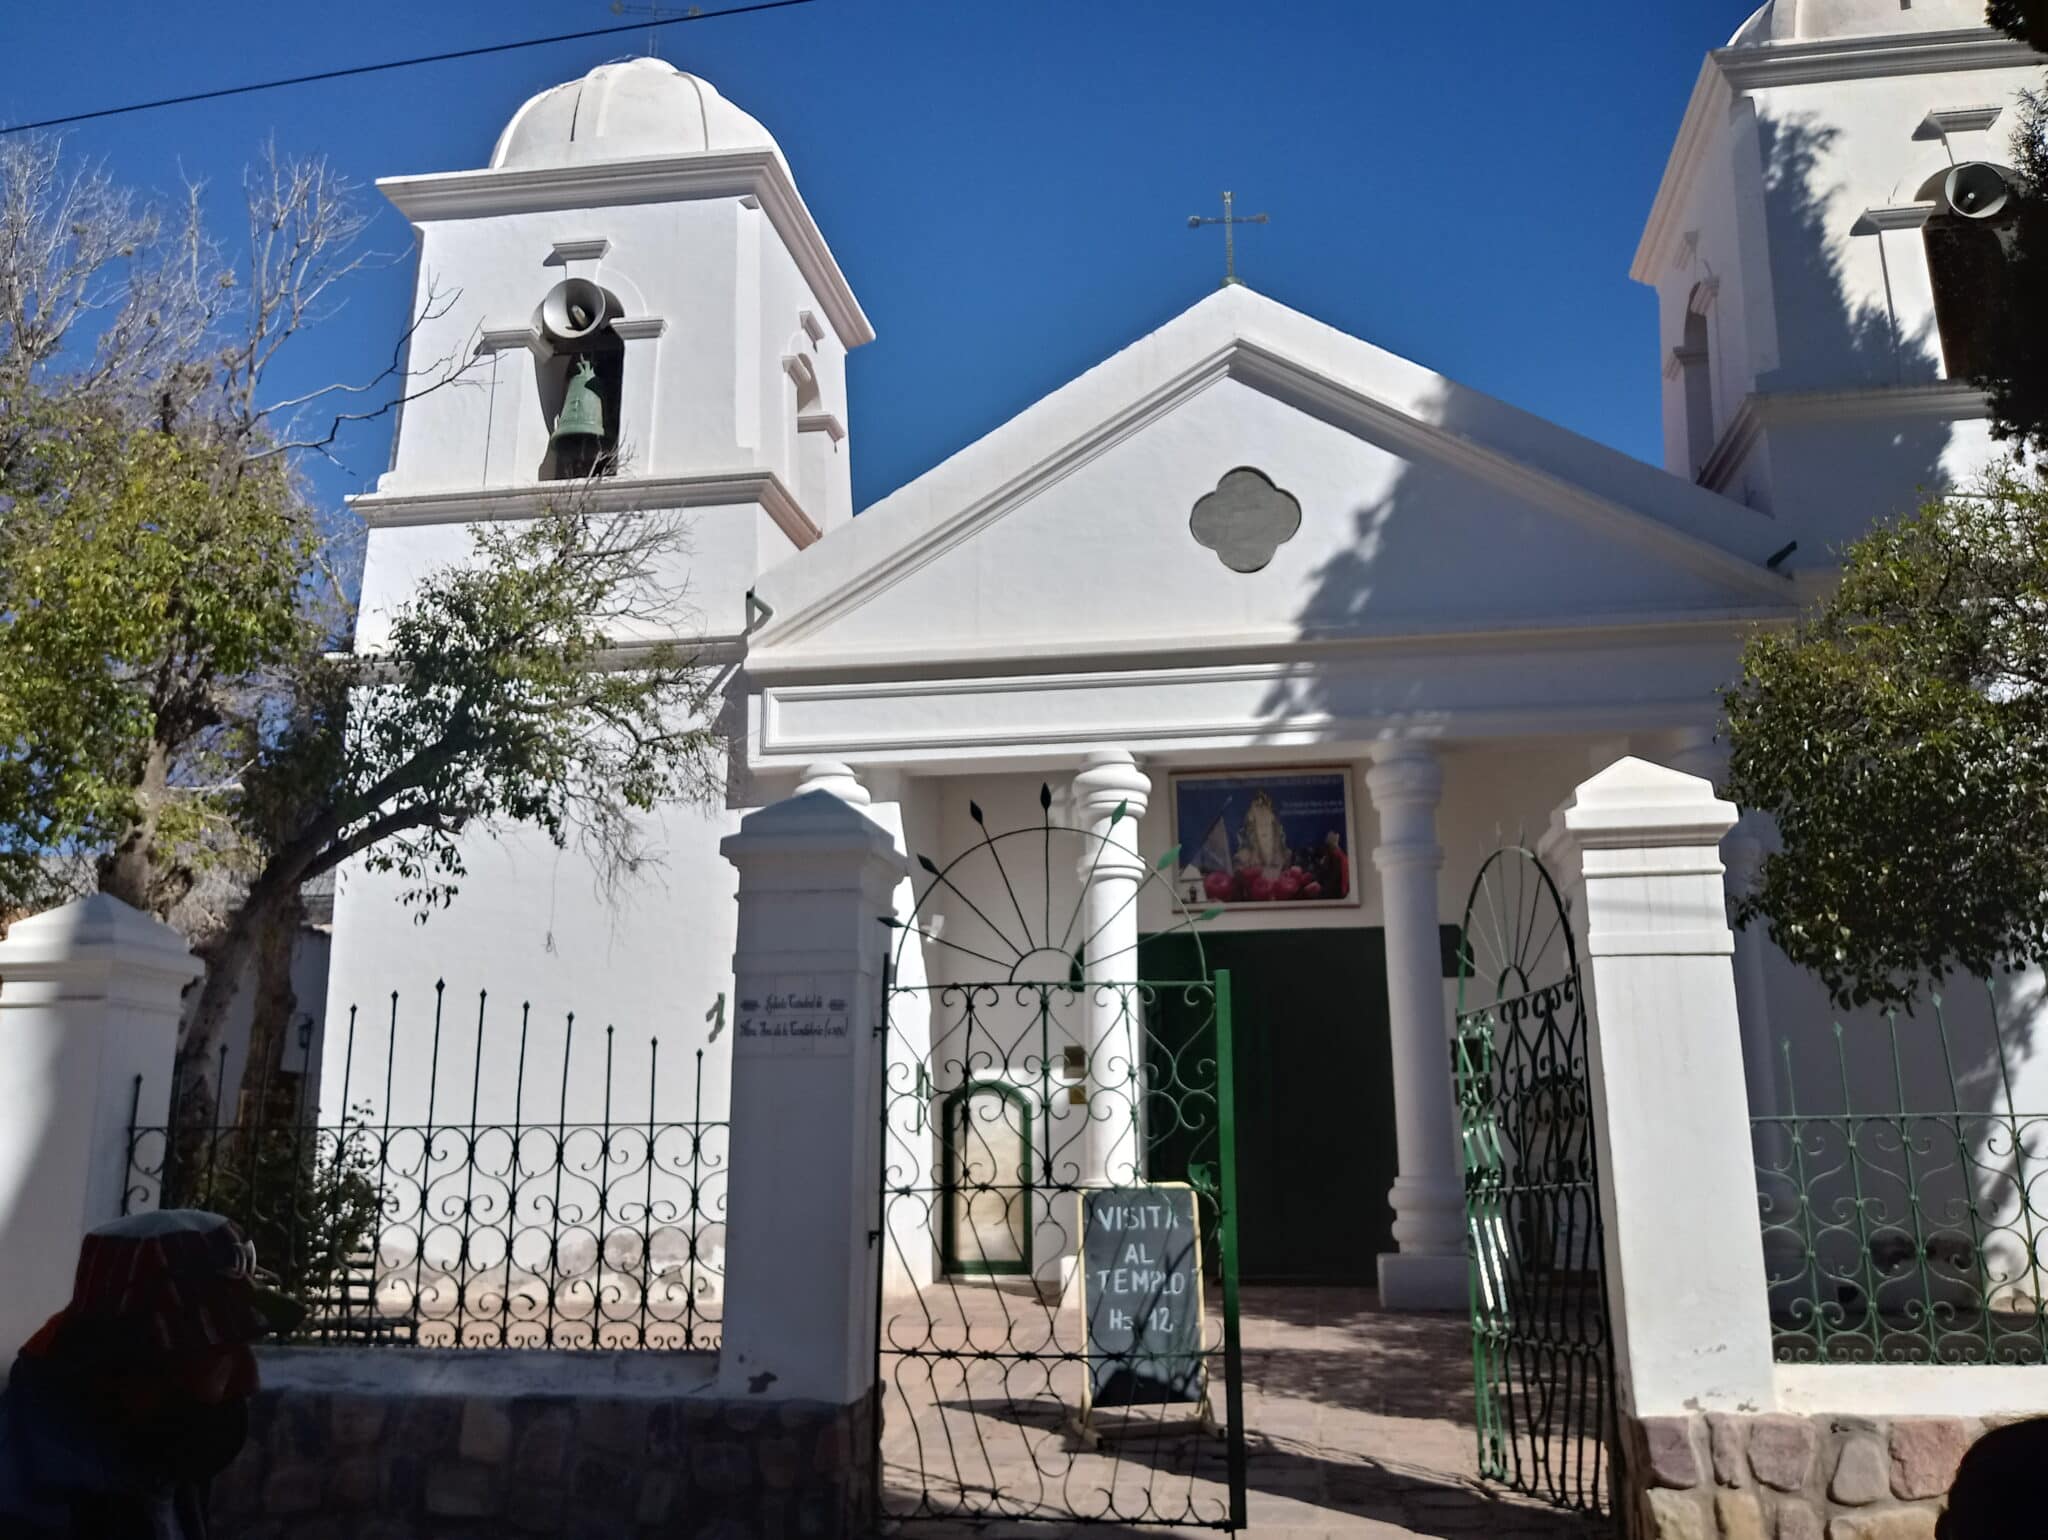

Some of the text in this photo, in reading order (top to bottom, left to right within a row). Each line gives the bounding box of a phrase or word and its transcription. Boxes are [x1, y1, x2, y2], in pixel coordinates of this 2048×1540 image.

[1097, 1206, 1179, 1232] VISITA
[1124, 1243, 1155, 1264] AL
[1096, 1268, 1186, 1295] TEMPLO
[1148, 1306, 1174, 1333] 12
